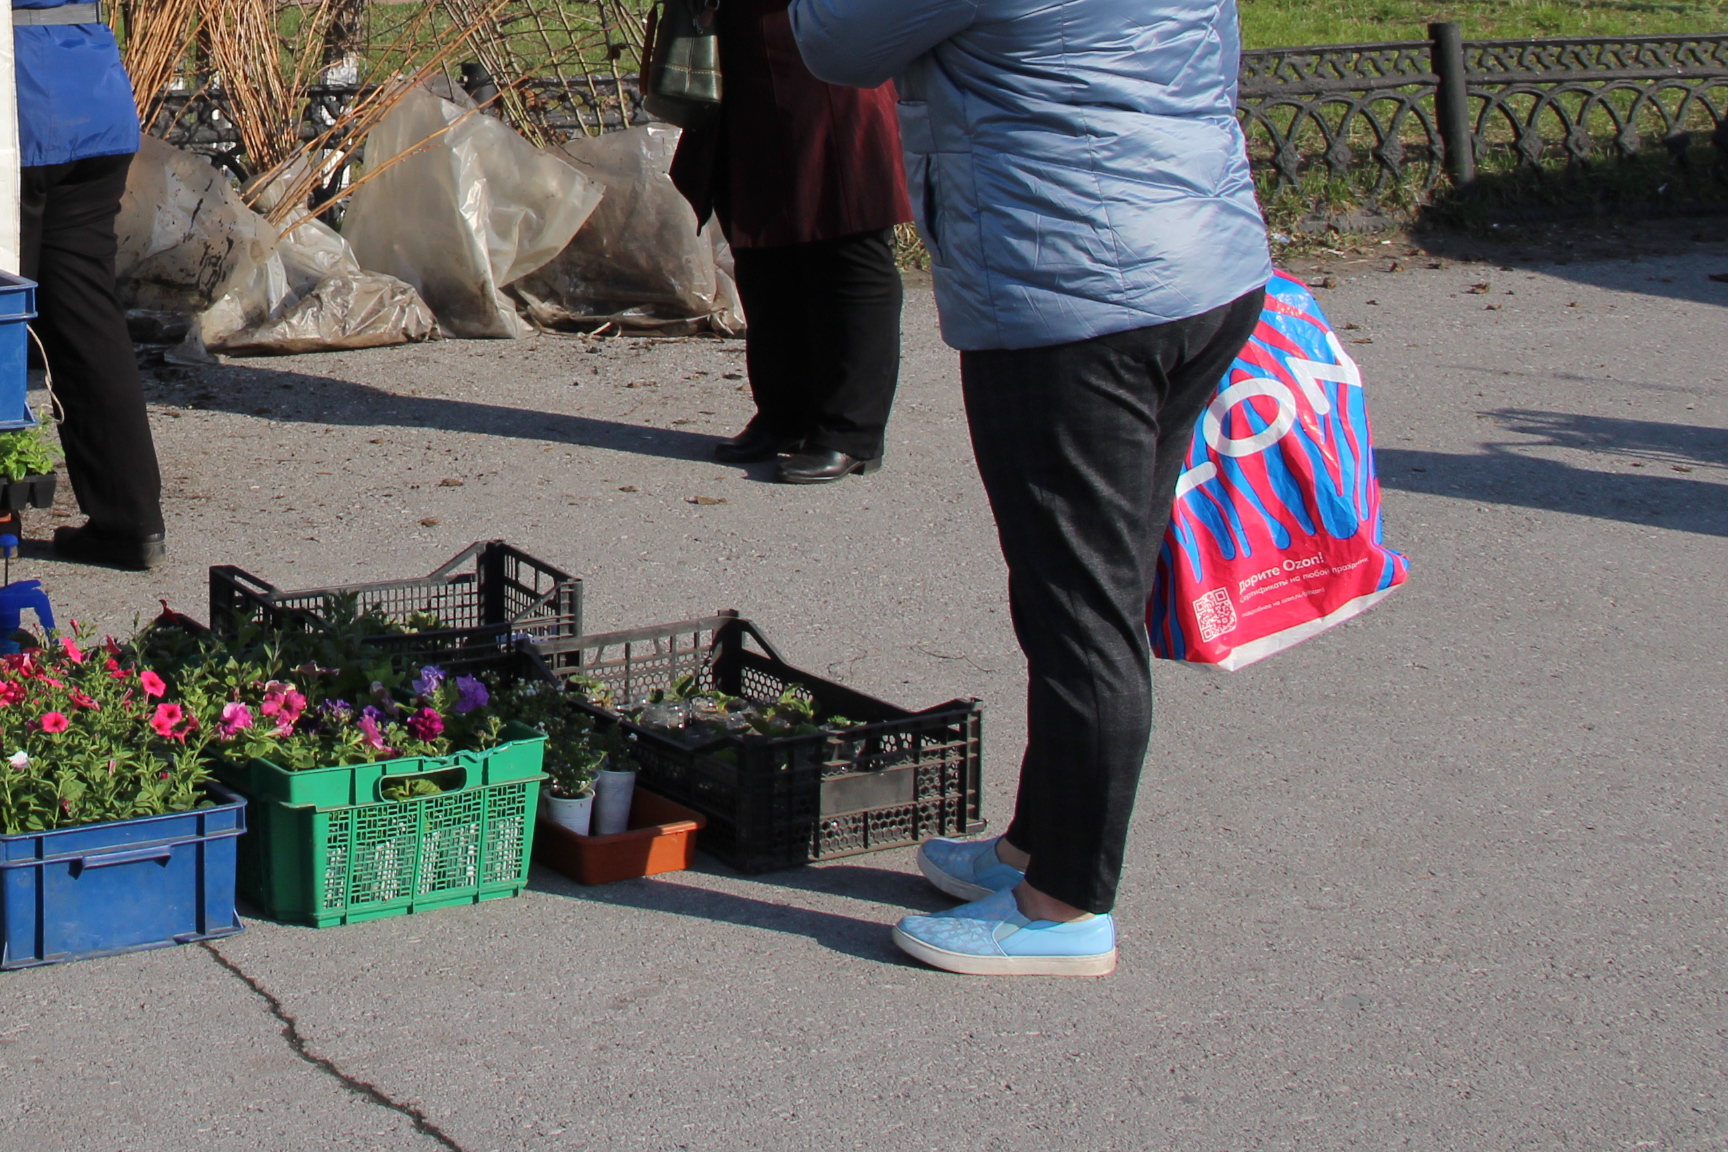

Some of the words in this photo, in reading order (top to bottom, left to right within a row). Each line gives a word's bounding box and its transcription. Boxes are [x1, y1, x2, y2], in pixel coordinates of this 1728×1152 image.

[1175, 331, 1362, 499] ON
[1239, 566, 1281, 596] Дарите
[1283, 552, 1325, 572] Ozon!
[1290, 575, 1301, 583] на
[1303, 569, 1330, 580] любой
[1332, 557, 1370, 575] праздник
